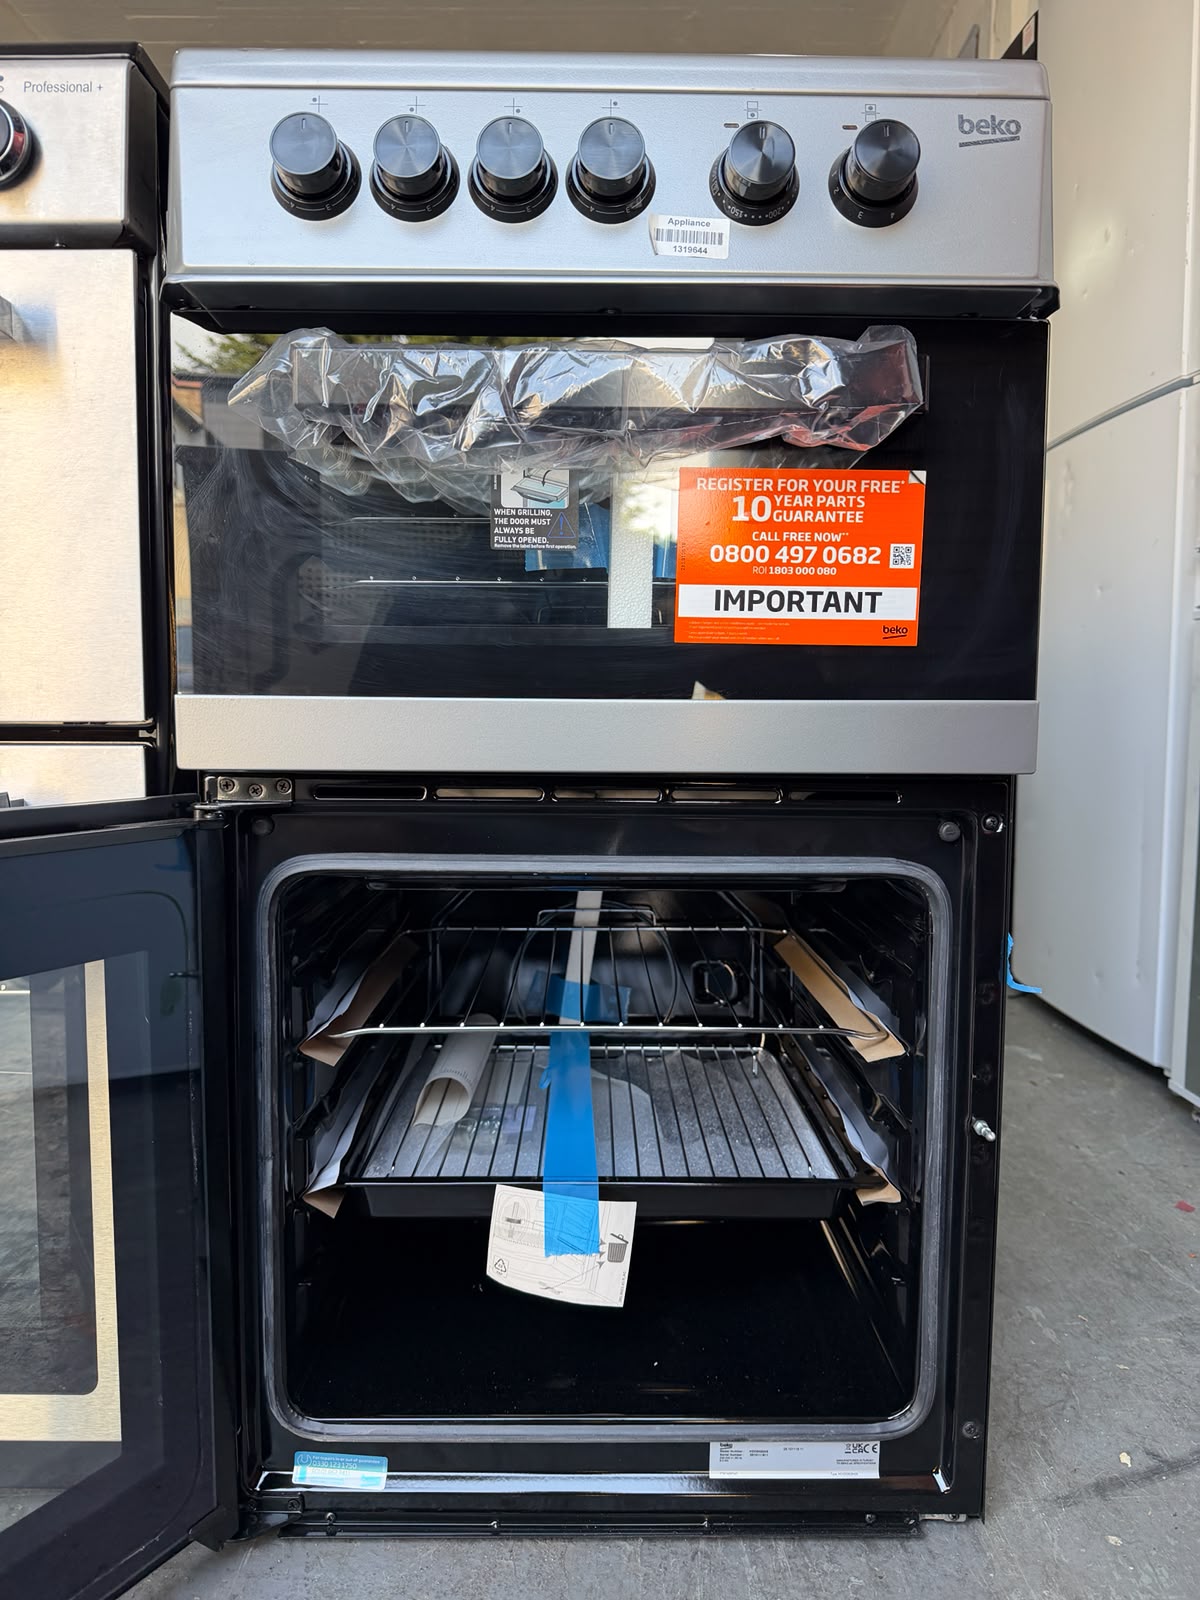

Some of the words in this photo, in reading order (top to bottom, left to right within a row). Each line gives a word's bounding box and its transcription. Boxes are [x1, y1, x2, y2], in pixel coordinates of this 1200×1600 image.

[23, 81, 93, 93] Professional
[958, 114, 1022, 136] beko
[668, 218, 711, 228] Appliance
[672, 245, 708, 254] 1319644
[696, 477, 774, 492] REGISTER
[777, 478, 809, 492] FOR
[813, 479, 857, 492] YOUR
[517, 509, 552, 517] GRILLING,
[732, 495, 772, 522] 10
[774, 494, 814, 507] YEAR
[816, 496, 866, 508] PARTS
[772, 510, 864, 523] GUARANTEE
[752, 531, 780, 542] CALL
[782, 532, 812, 542] FREE
[710, 544, 770, 563] 0800
[774, 546, 818, 564] 497
[822, 546, 882, 564] 0682
[752, 566, 768, 574] ROI
[768, 566, 794, 575] 1803
[795, 567, 815, 576] 000
[816, 567, 837, 576] 080
[714, 589, 882, 614] IMPORTANT
[882, 625, 908, 634] beko
